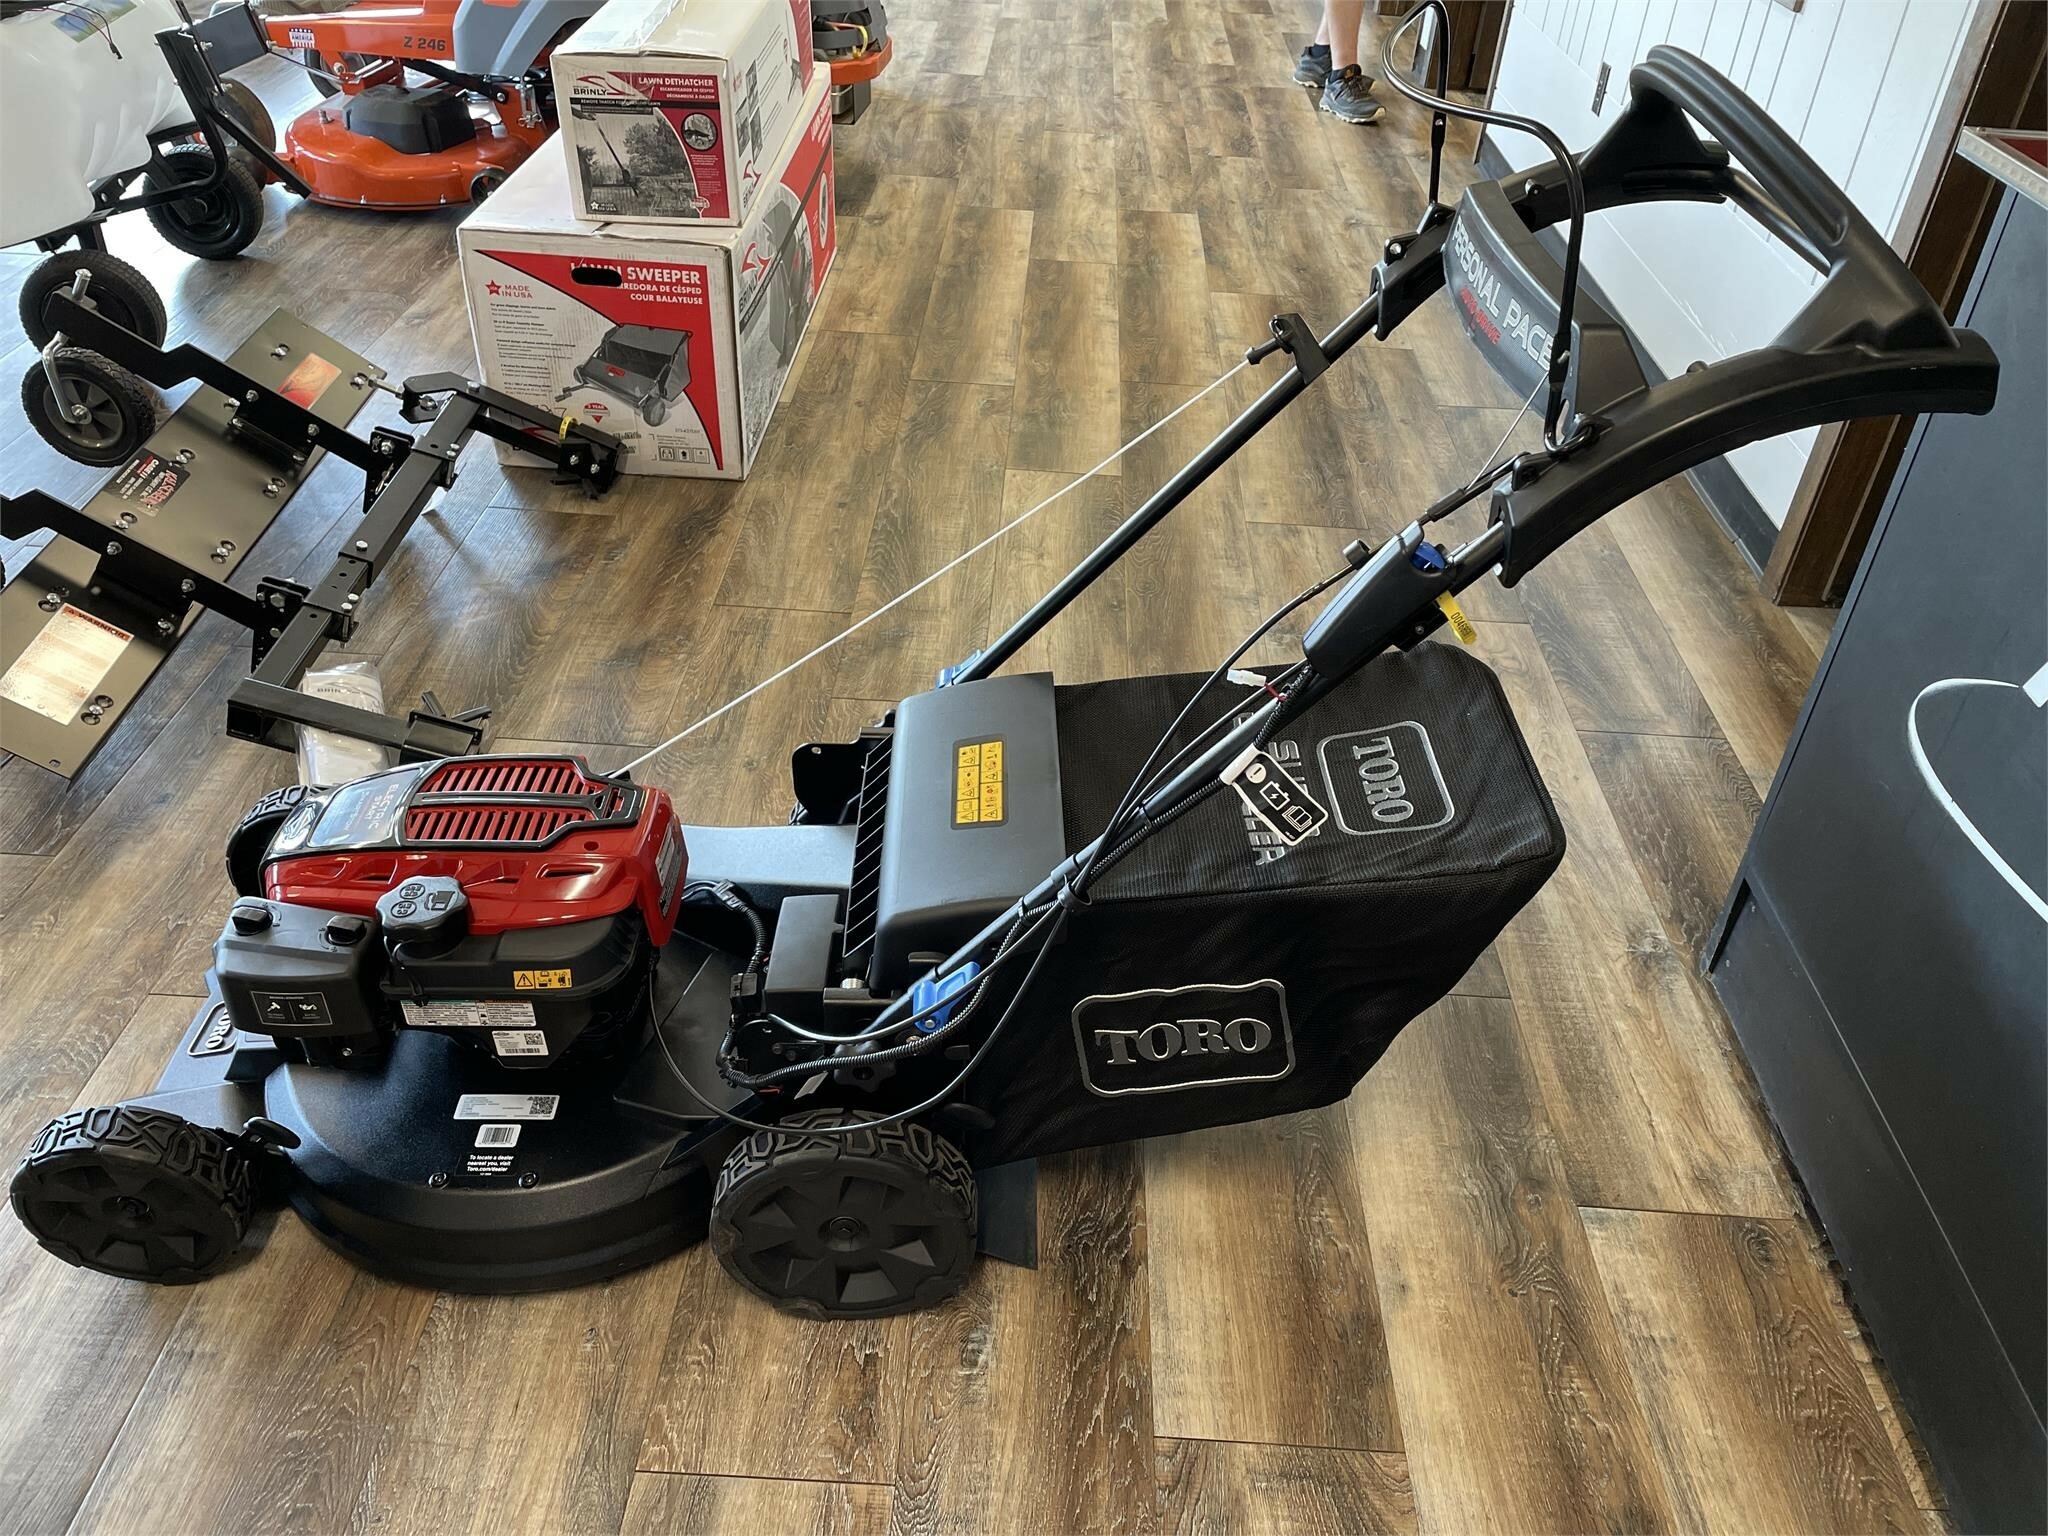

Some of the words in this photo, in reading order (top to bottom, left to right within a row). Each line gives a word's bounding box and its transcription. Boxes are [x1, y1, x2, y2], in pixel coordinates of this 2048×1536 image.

[404, 36, 413, 48] Z
[418, 38, 446, 51] 246
[638, 77, 664, 85] LAWN
[665, 78, 714, 87] DETHATCHER
[573, 88, 607, 96] BRINLY
[627, 266, 701, 284] SWEEPER
[504, 284, 530, 292] MADE
[513, 291, 533, 299] USA
[659, 284, 671, 293] DE
[672, 284, 702, 295] CÉSPED
[1452, 215, 1501, 318] PERSONAL
[1502, 298, 1553, 370] PACE
[630, 293, 655, 301] COUR
[656, 294, 703, 305] BALAYEUSE
[1352, 735, 1414, 823] TORO
[368, 783, 400, 830] ELECTRIC
[204, 1007, 232, 1050] ORO
[1094, 1018, 1272, 1065] TORO
